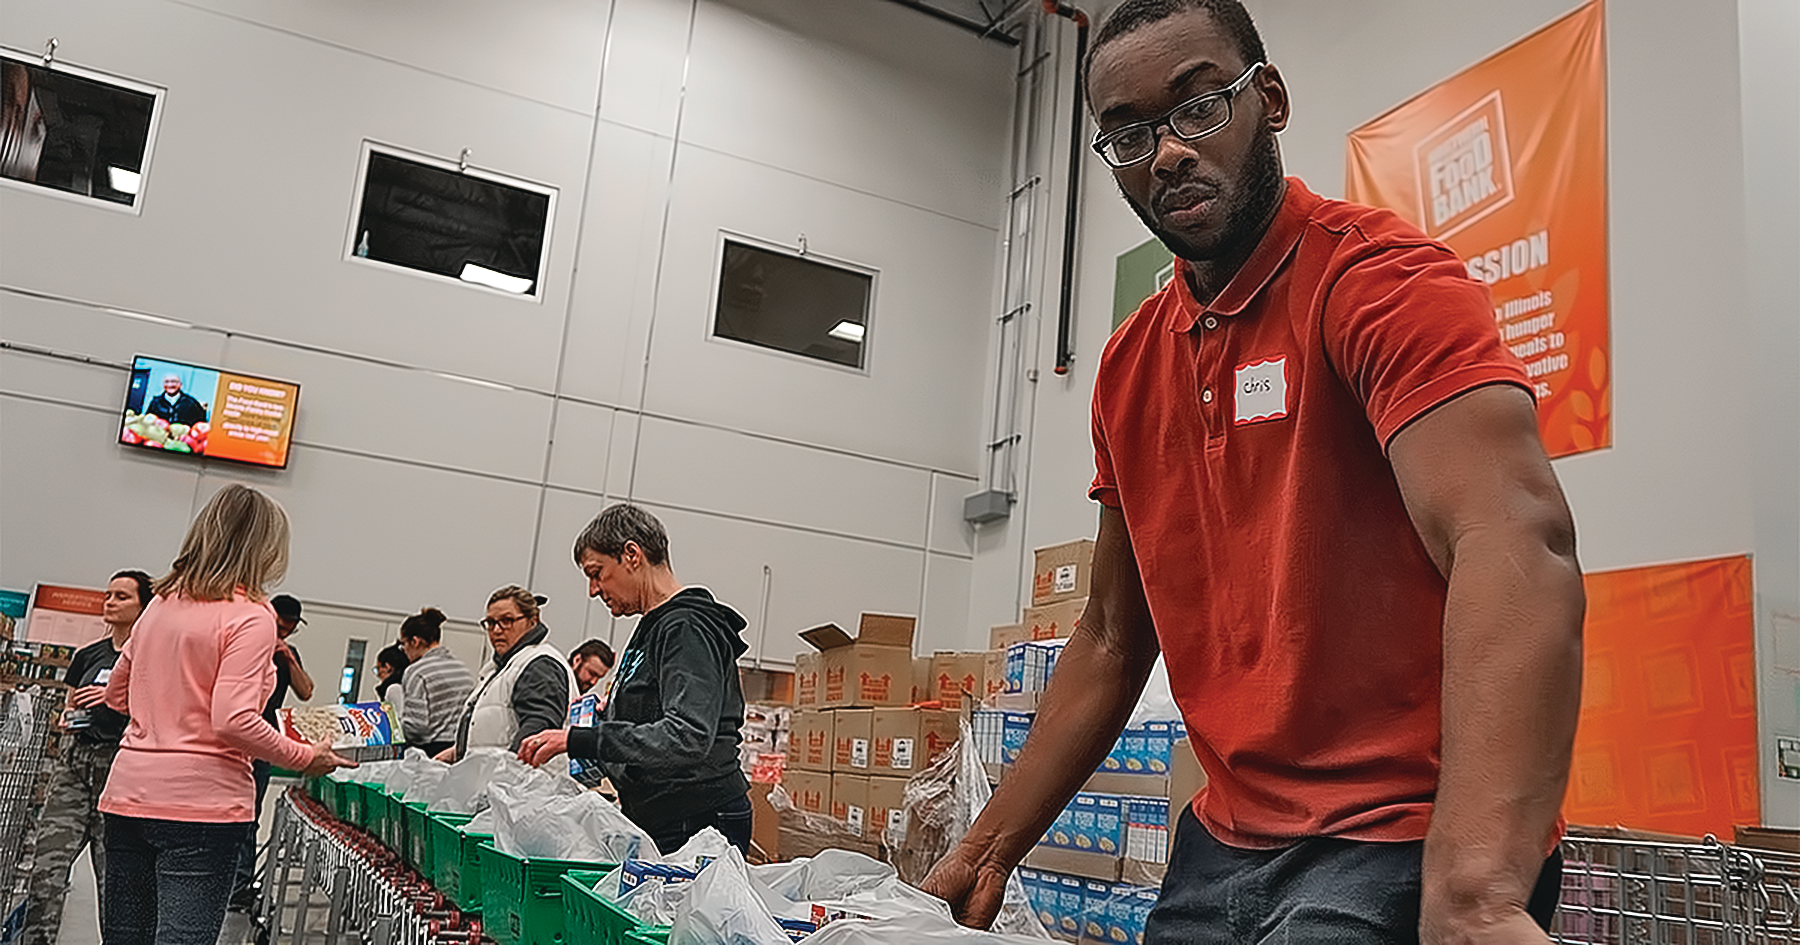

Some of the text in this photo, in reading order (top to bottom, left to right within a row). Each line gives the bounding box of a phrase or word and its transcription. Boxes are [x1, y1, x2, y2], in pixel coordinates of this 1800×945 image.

[1433, 166, 1498, 227] BANK
[1463, 229, 1548, 285] SSION
[1504, 290, 1552, 319] Illinois
[1505, 312, 1555, 340] hunger
